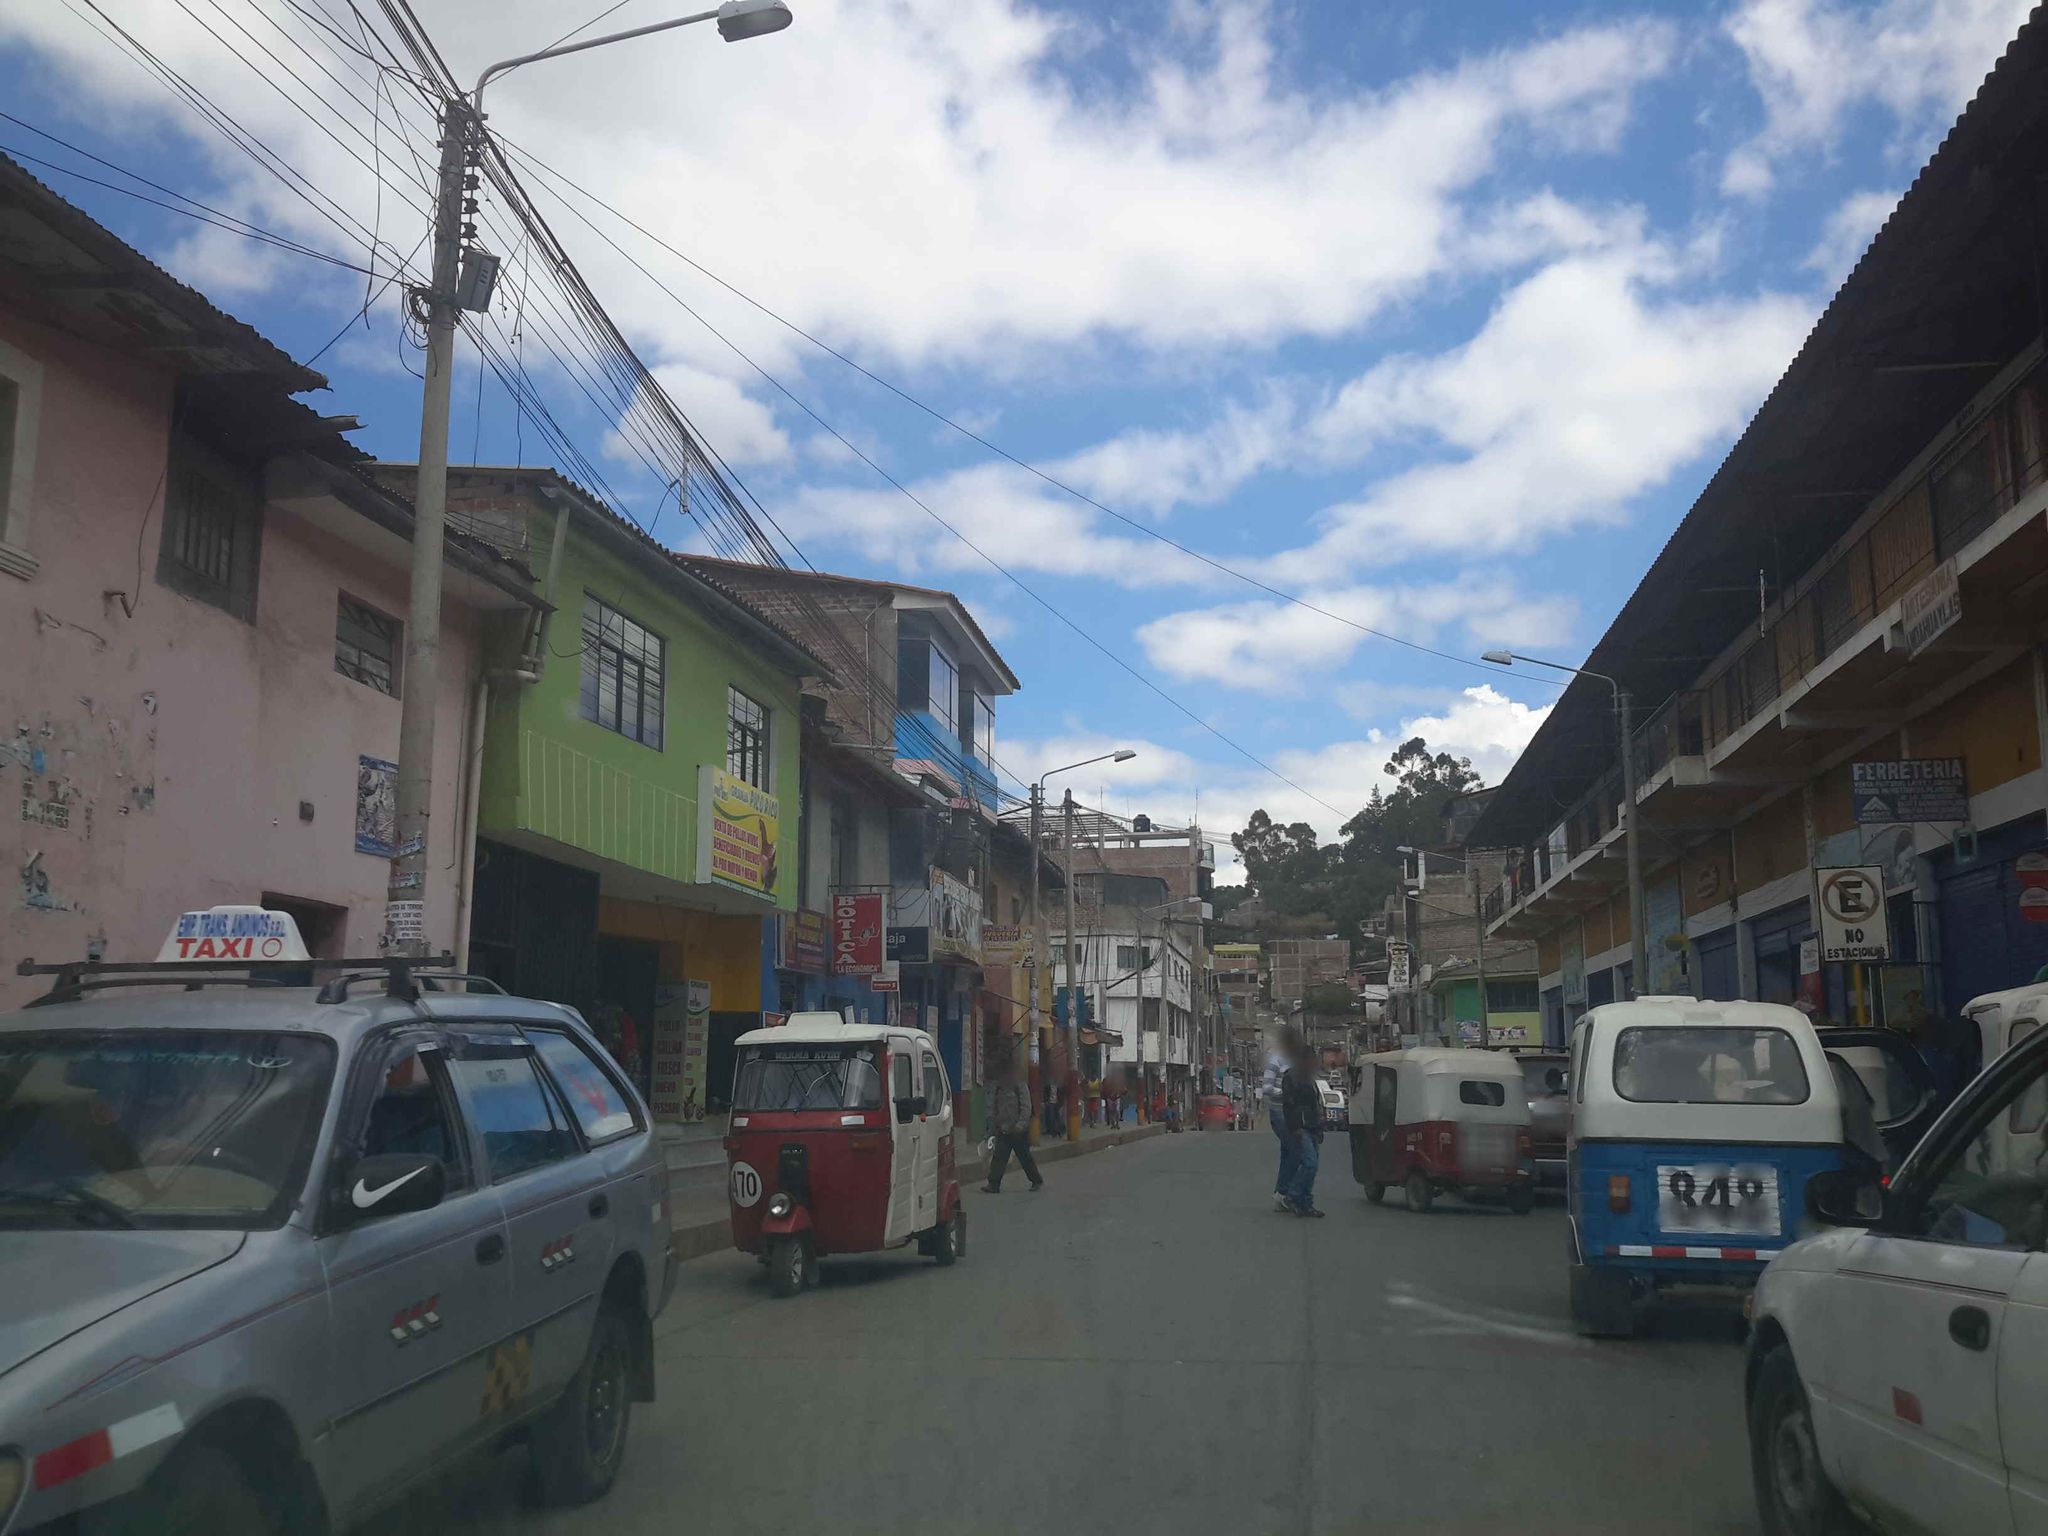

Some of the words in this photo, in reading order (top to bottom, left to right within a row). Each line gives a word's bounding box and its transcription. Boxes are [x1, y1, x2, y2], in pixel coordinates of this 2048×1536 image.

[1852, 759, 1964, 780] FERRETERIA
[835, 895, 857, 963] BOTICA
[1845, 928, 1864, 943] NO
[176, 938, 254, 958] TAXI
[1827, 946, 1886, 959] ESTACIONAR
